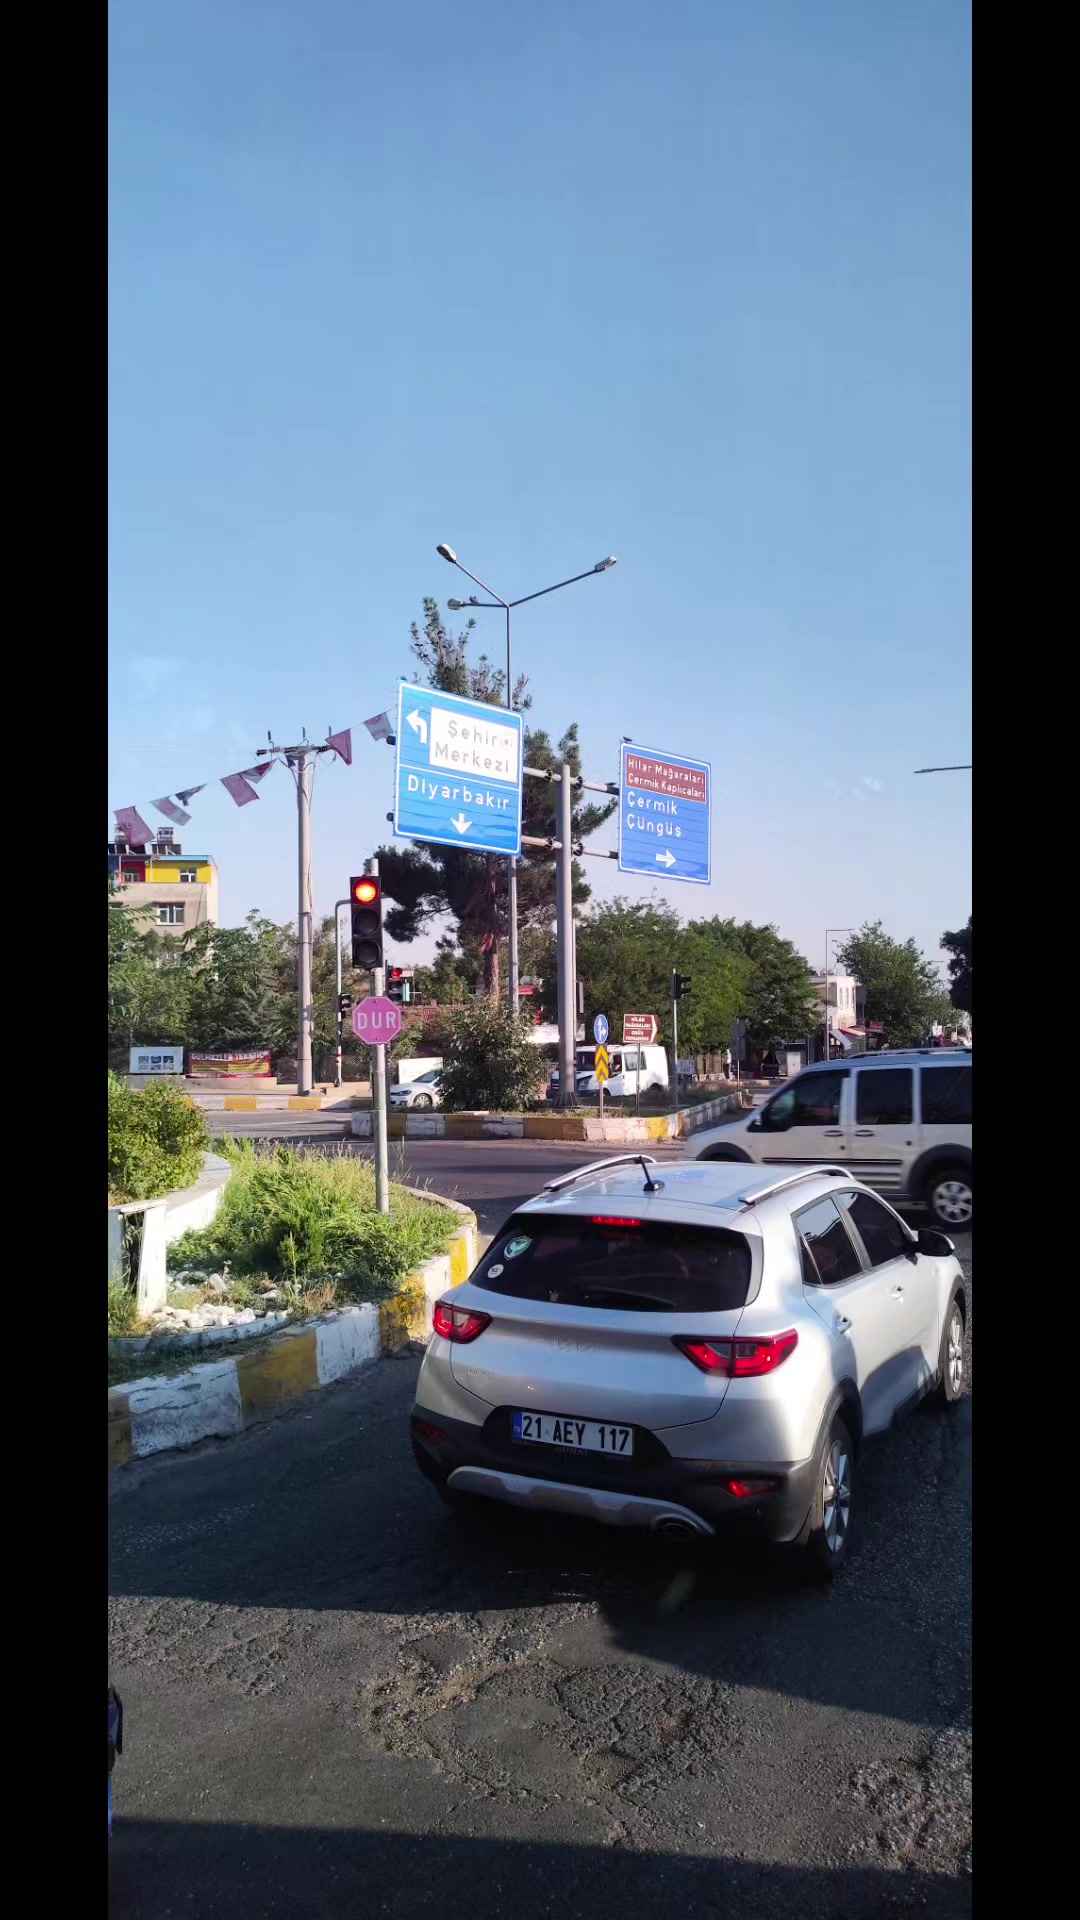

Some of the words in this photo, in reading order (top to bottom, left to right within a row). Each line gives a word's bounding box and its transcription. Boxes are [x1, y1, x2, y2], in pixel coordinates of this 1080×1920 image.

[448, 719, 497, 746] Şehir
[434, 741, 509, 773] Merkezi
[628, 757, 652, 772] Hilar
[655, 765, 704, 785] Mağaraları
[628, 773, 660, 789] Çermik
[407, 774, 510, 811] Diyarbakır
[627, 791, 678, 815] Çermik
[627, 813, 682, 838] Çüngüş
[357, 1011, 397, 1030] DUR
[522, 1415, 542, 1439] 21
[552, 1419, 586, 1446] AEY
[598, 1426, 630, 1452] 117
